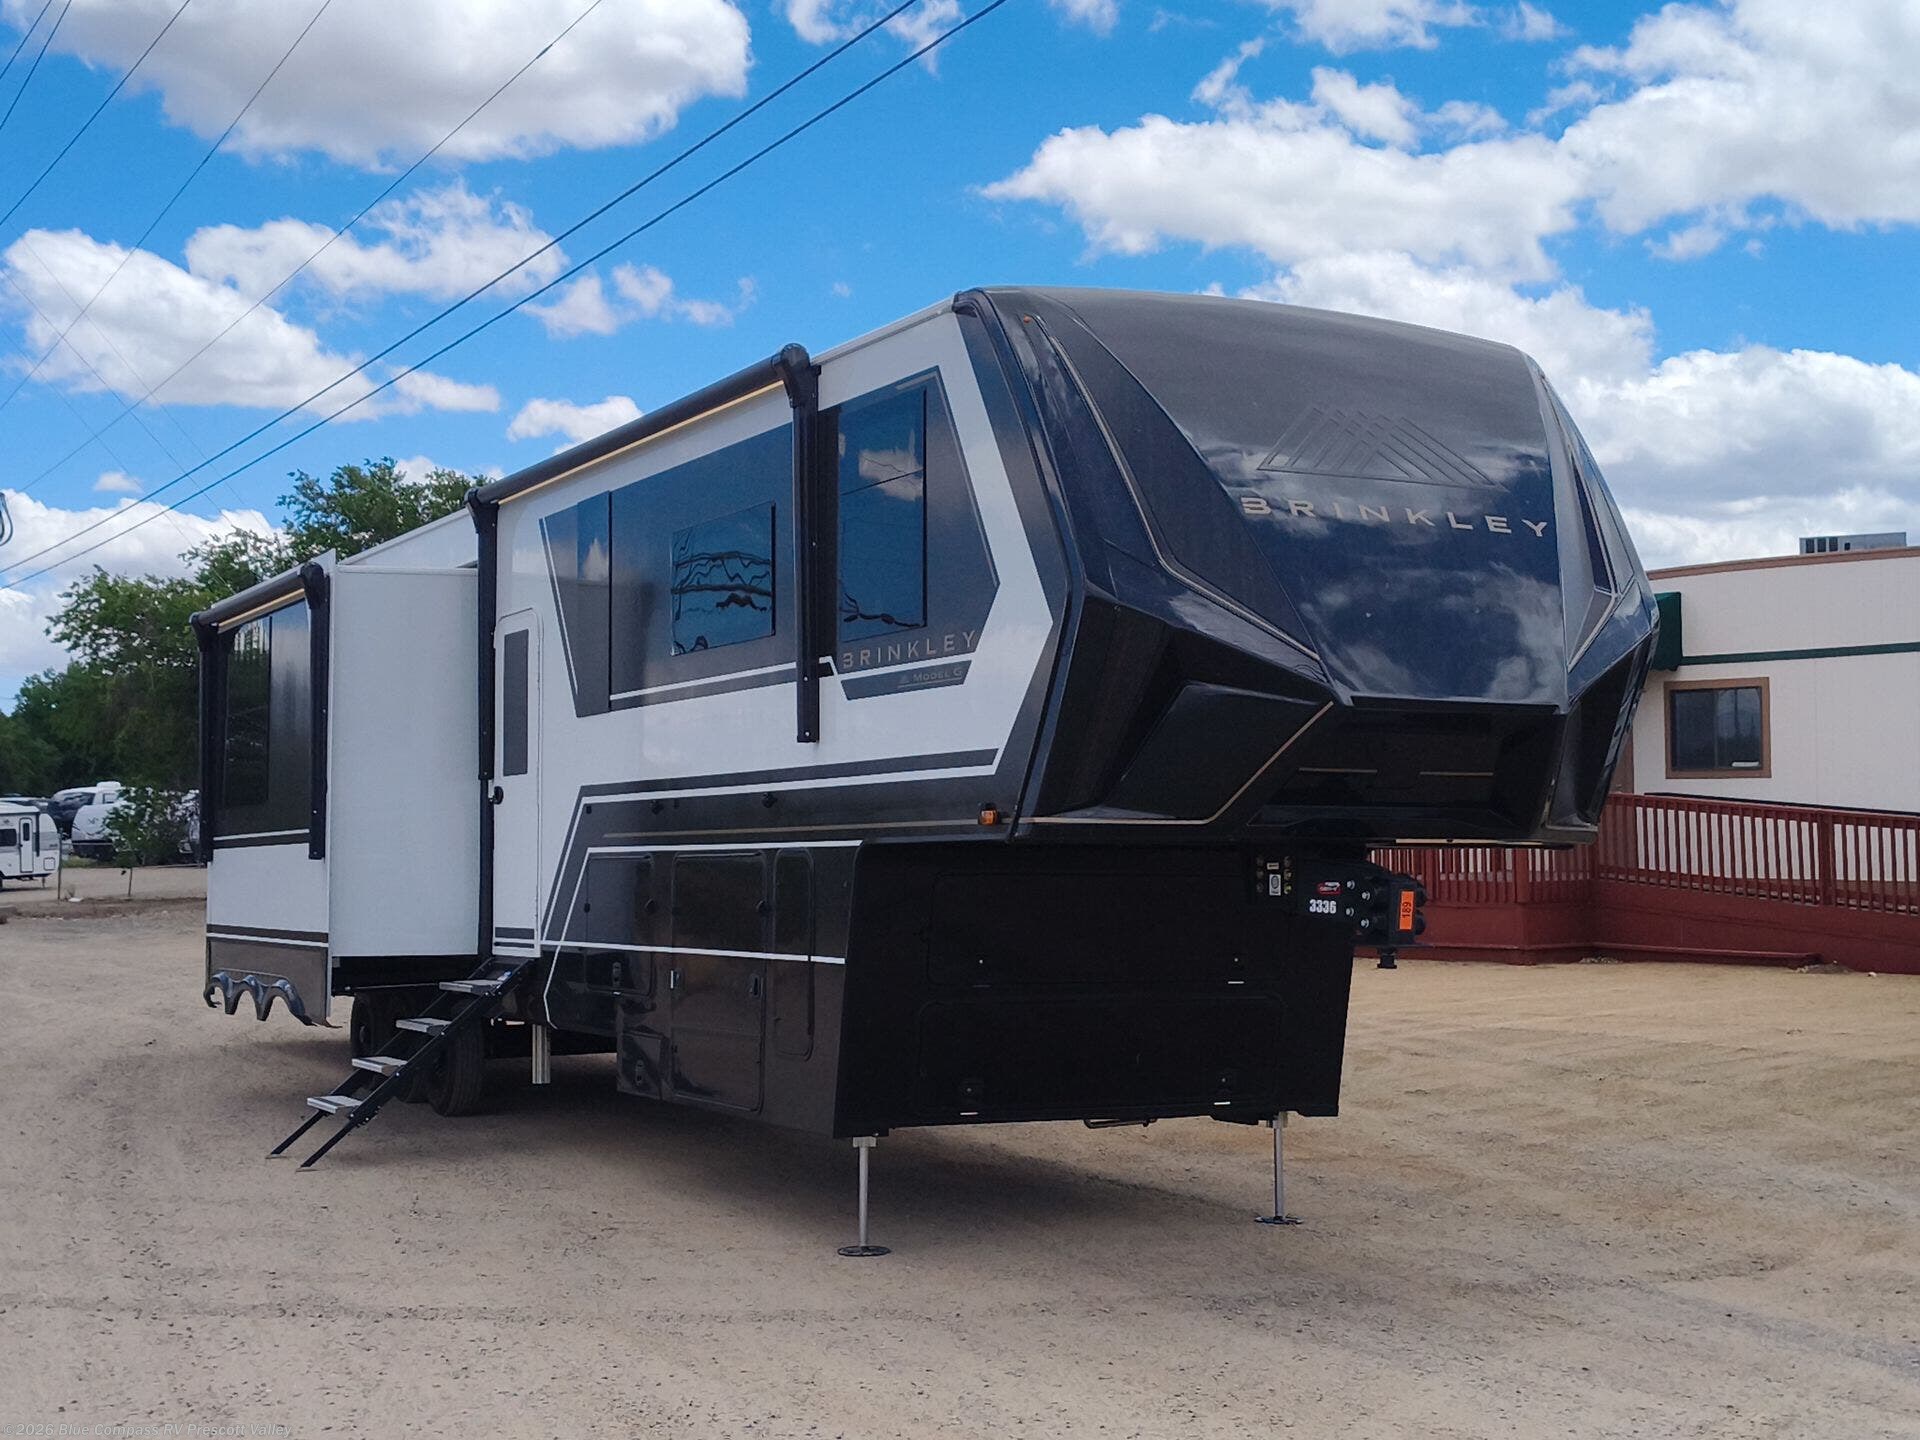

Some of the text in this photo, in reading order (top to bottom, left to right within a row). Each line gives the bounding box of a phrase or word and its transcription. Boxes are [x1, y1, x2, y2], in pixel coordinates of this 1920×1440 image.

[1241, 496, 1548, 537] BRINKLEY
[843, 631, 975, 668] BRINKLEY
[1309, 899, 1337, 914] 3336
